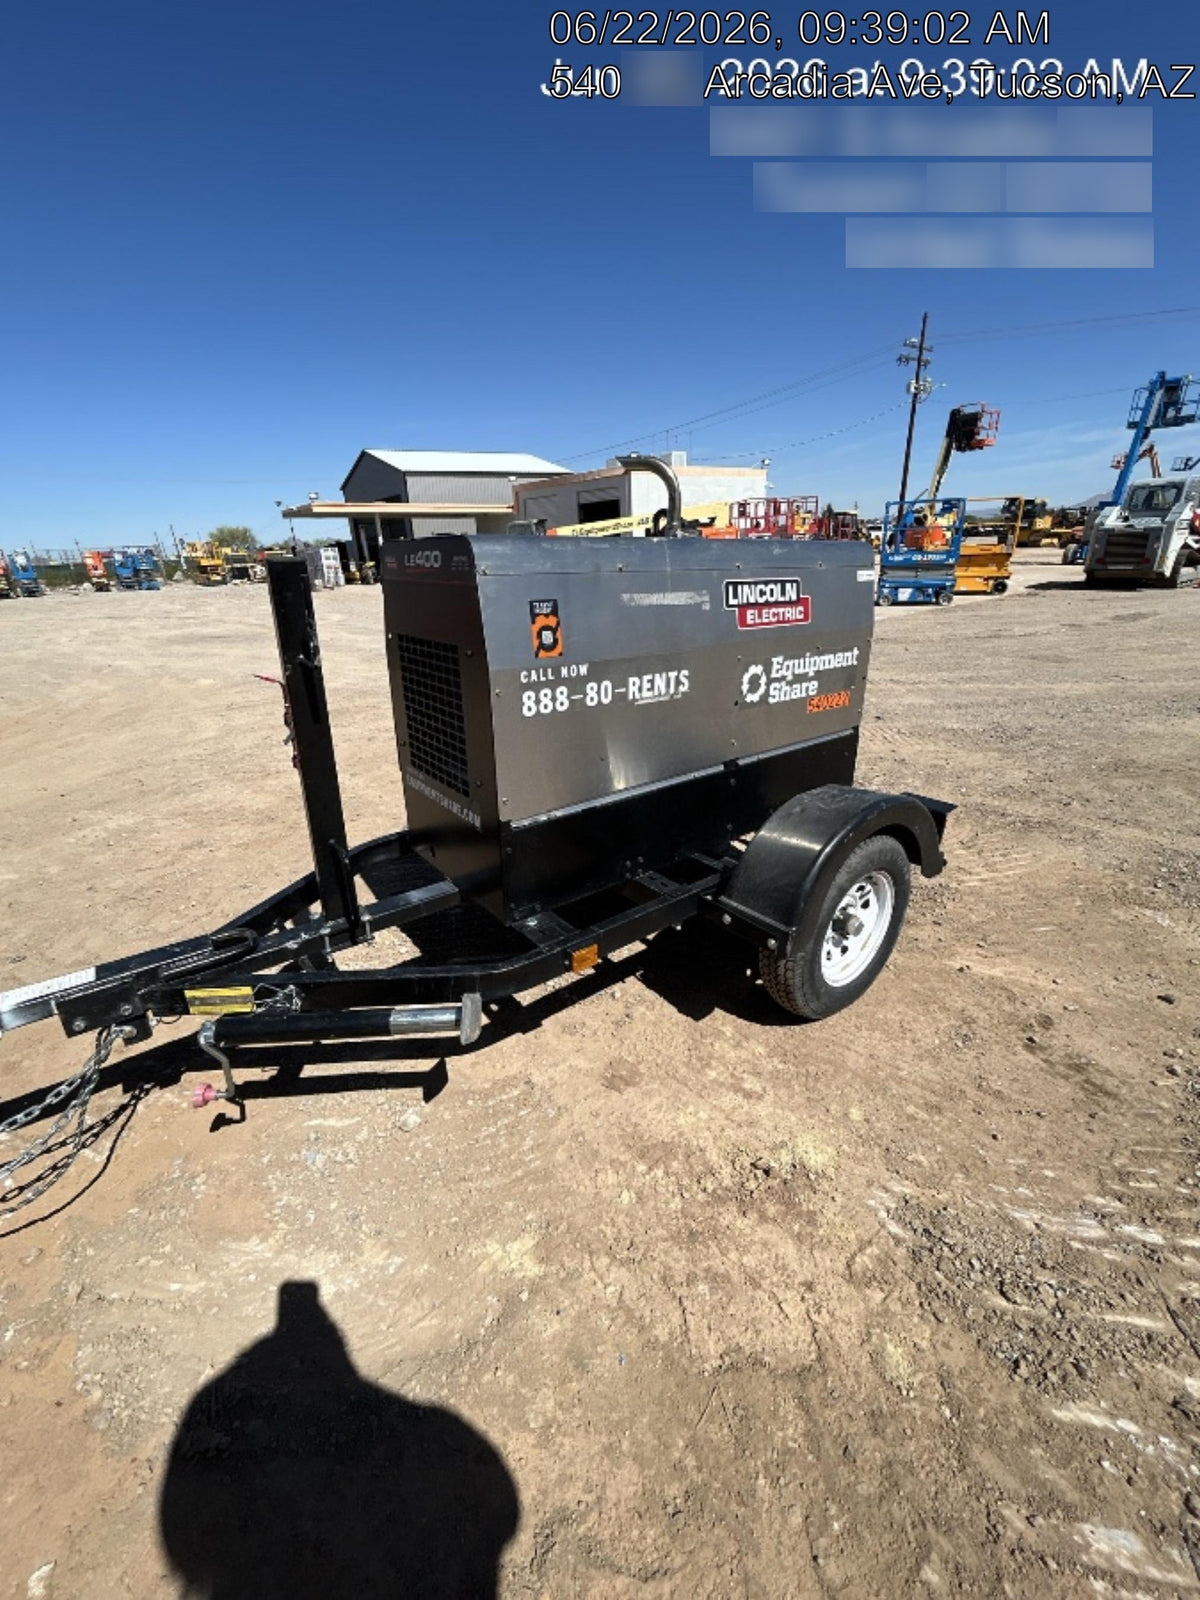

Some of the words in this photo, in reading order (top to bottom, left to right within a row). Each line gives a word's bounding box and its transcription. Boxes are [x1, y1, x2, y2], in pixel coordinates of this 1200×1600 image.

[728, 582, 797, 606] LINCOLN
[746, 606, 805, 625] ELECTRIC
[520, 667, 555, 683] CALL
[561, 662, 590, 678] NOW
[769, 646, 860, 681] Equipment
[521, 669, 690, 718] 888-80-RENTS
[767, 680, 819, 705] Share
